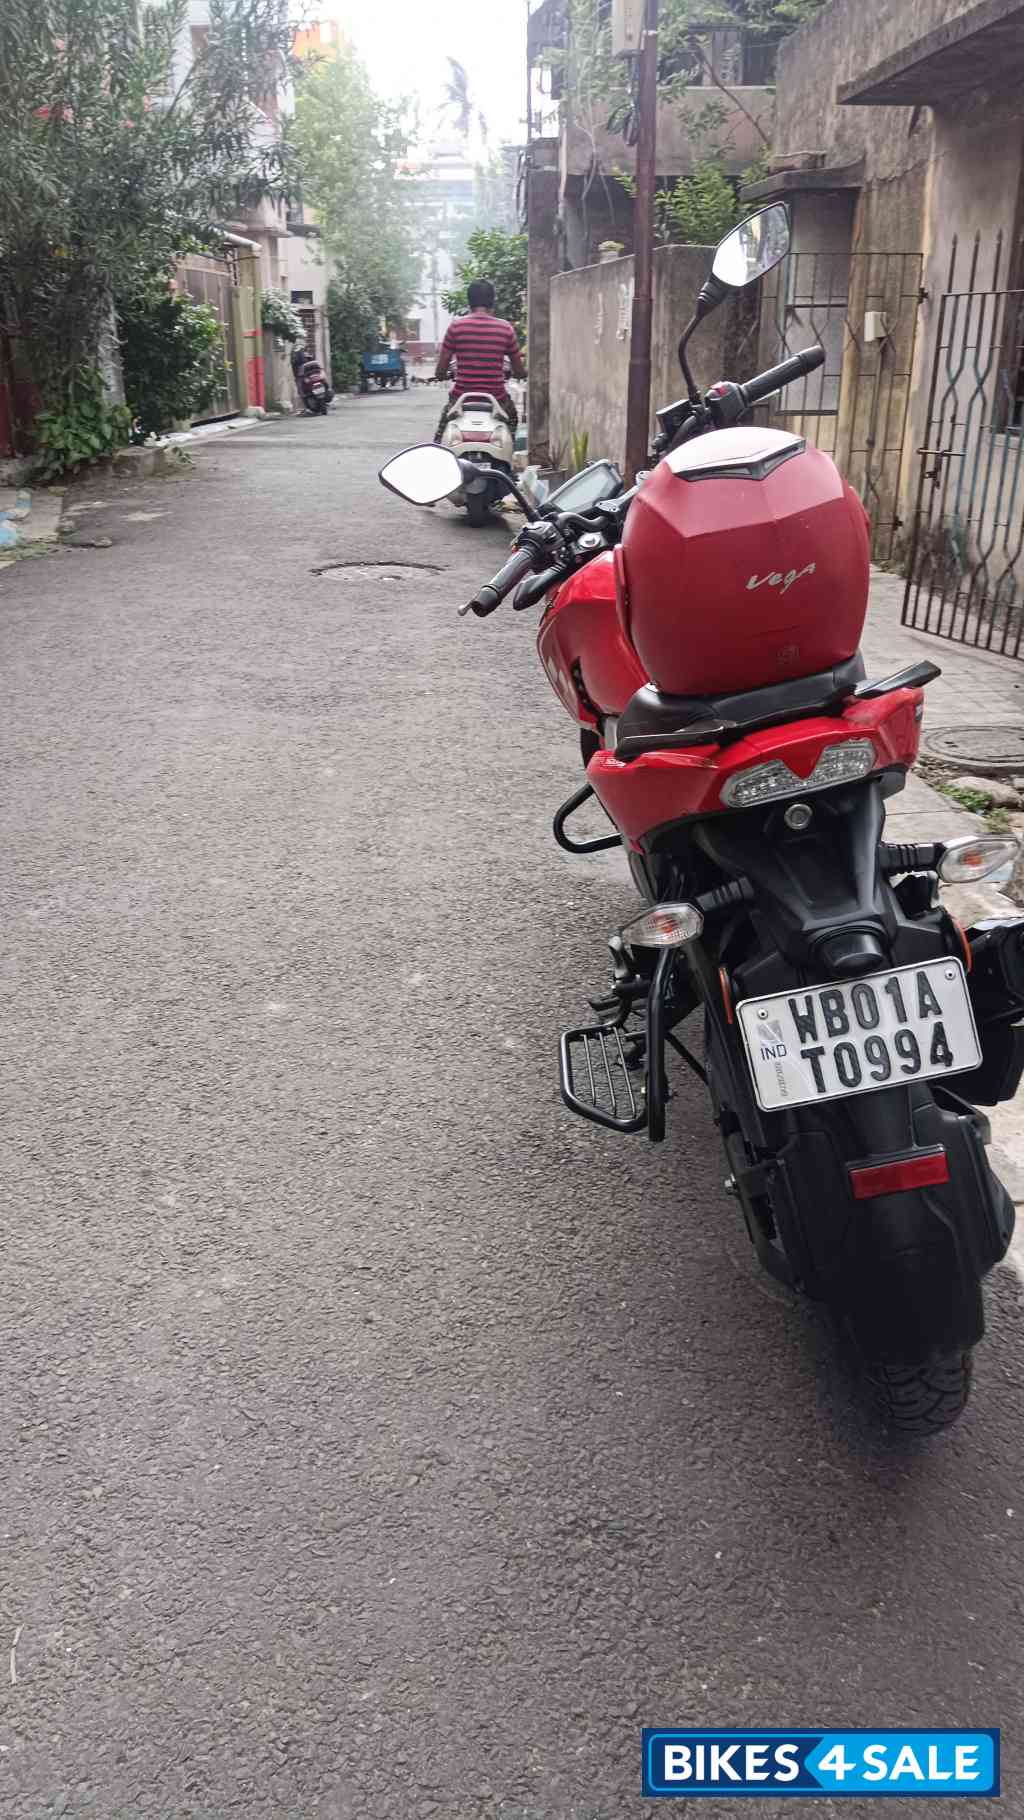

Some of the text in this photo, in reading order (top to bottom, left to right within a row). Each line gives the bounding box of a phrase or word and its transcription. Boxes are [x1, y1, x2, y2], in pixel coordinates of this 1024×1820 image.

[788, 971, 942, 1043] WB01A
[760, 1044, 787, 1061] IND
[800, 1021, 954, 1093] T0994
